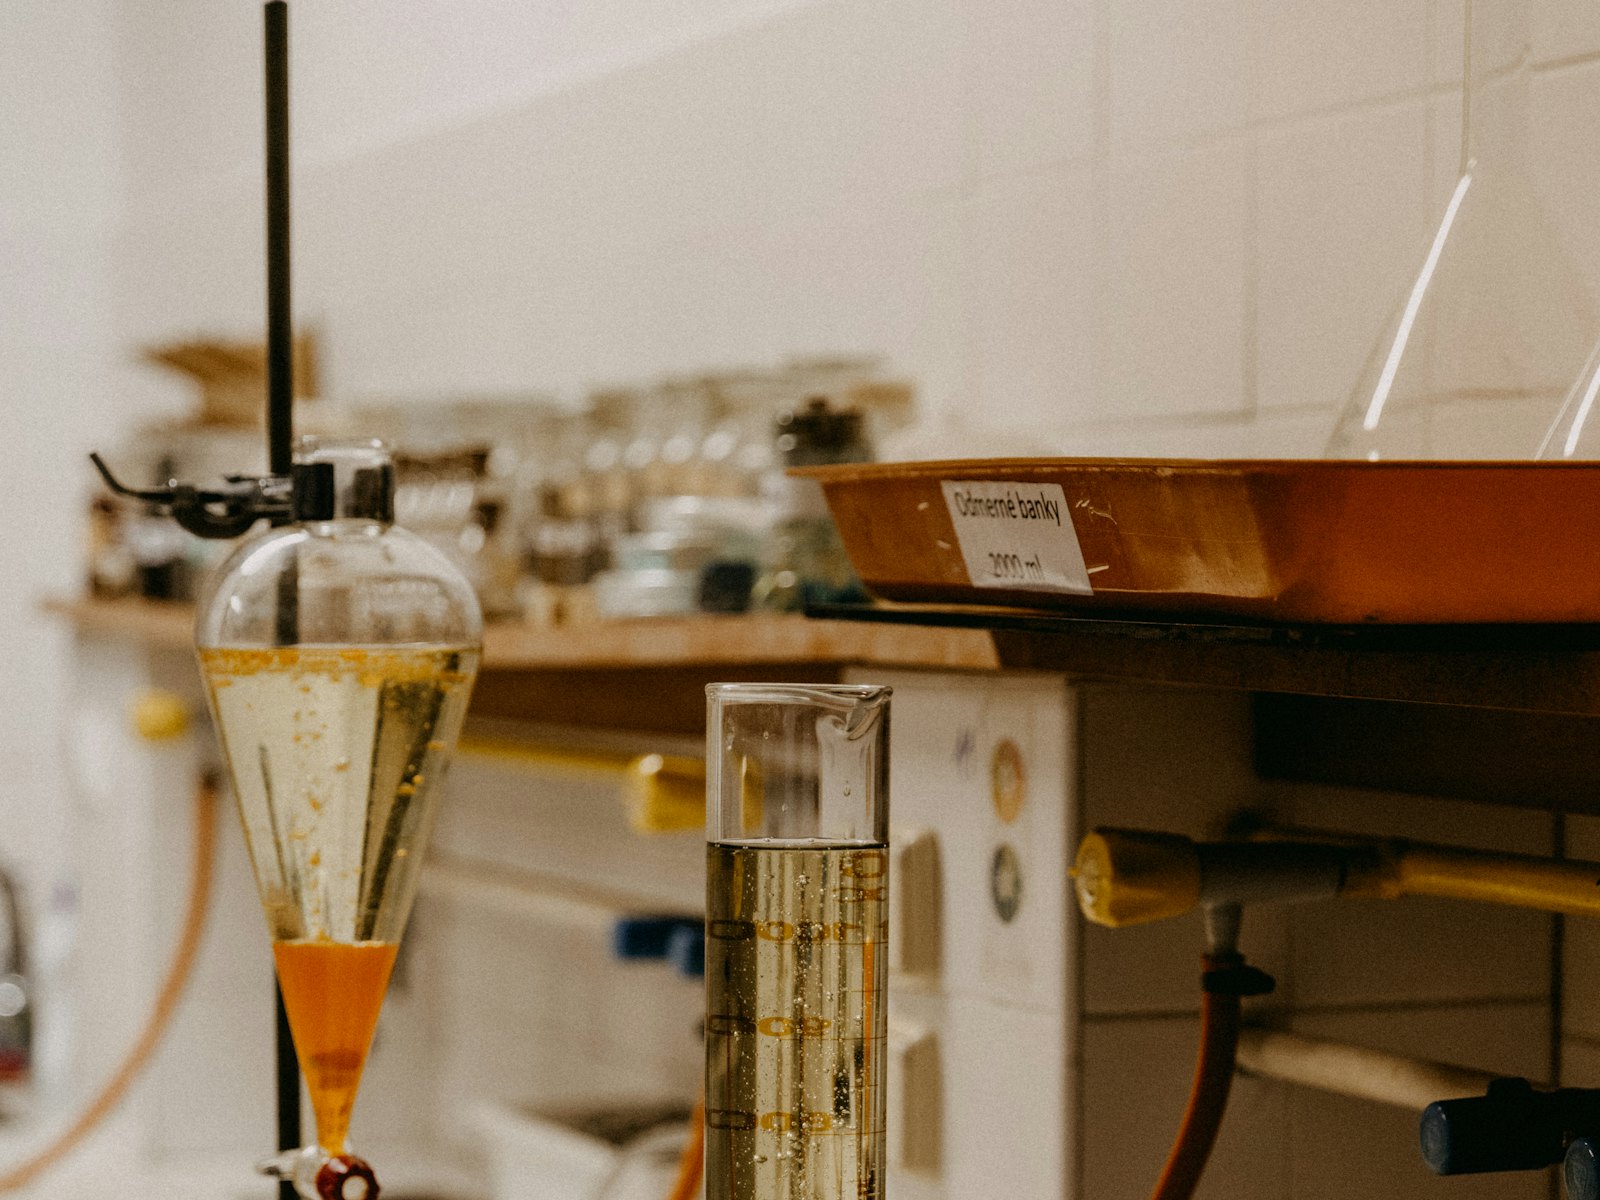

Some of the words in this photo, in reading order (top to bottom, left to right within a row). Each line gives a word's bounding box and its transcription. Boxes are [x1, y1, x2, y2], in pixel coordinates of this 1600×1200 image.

[954, 490, 1017, 518] Odmerné
[1015, 491, 1061, 527] banky
[988, 552, 1024, 579] 2000
[1025, 554, 1045, 580] ml
